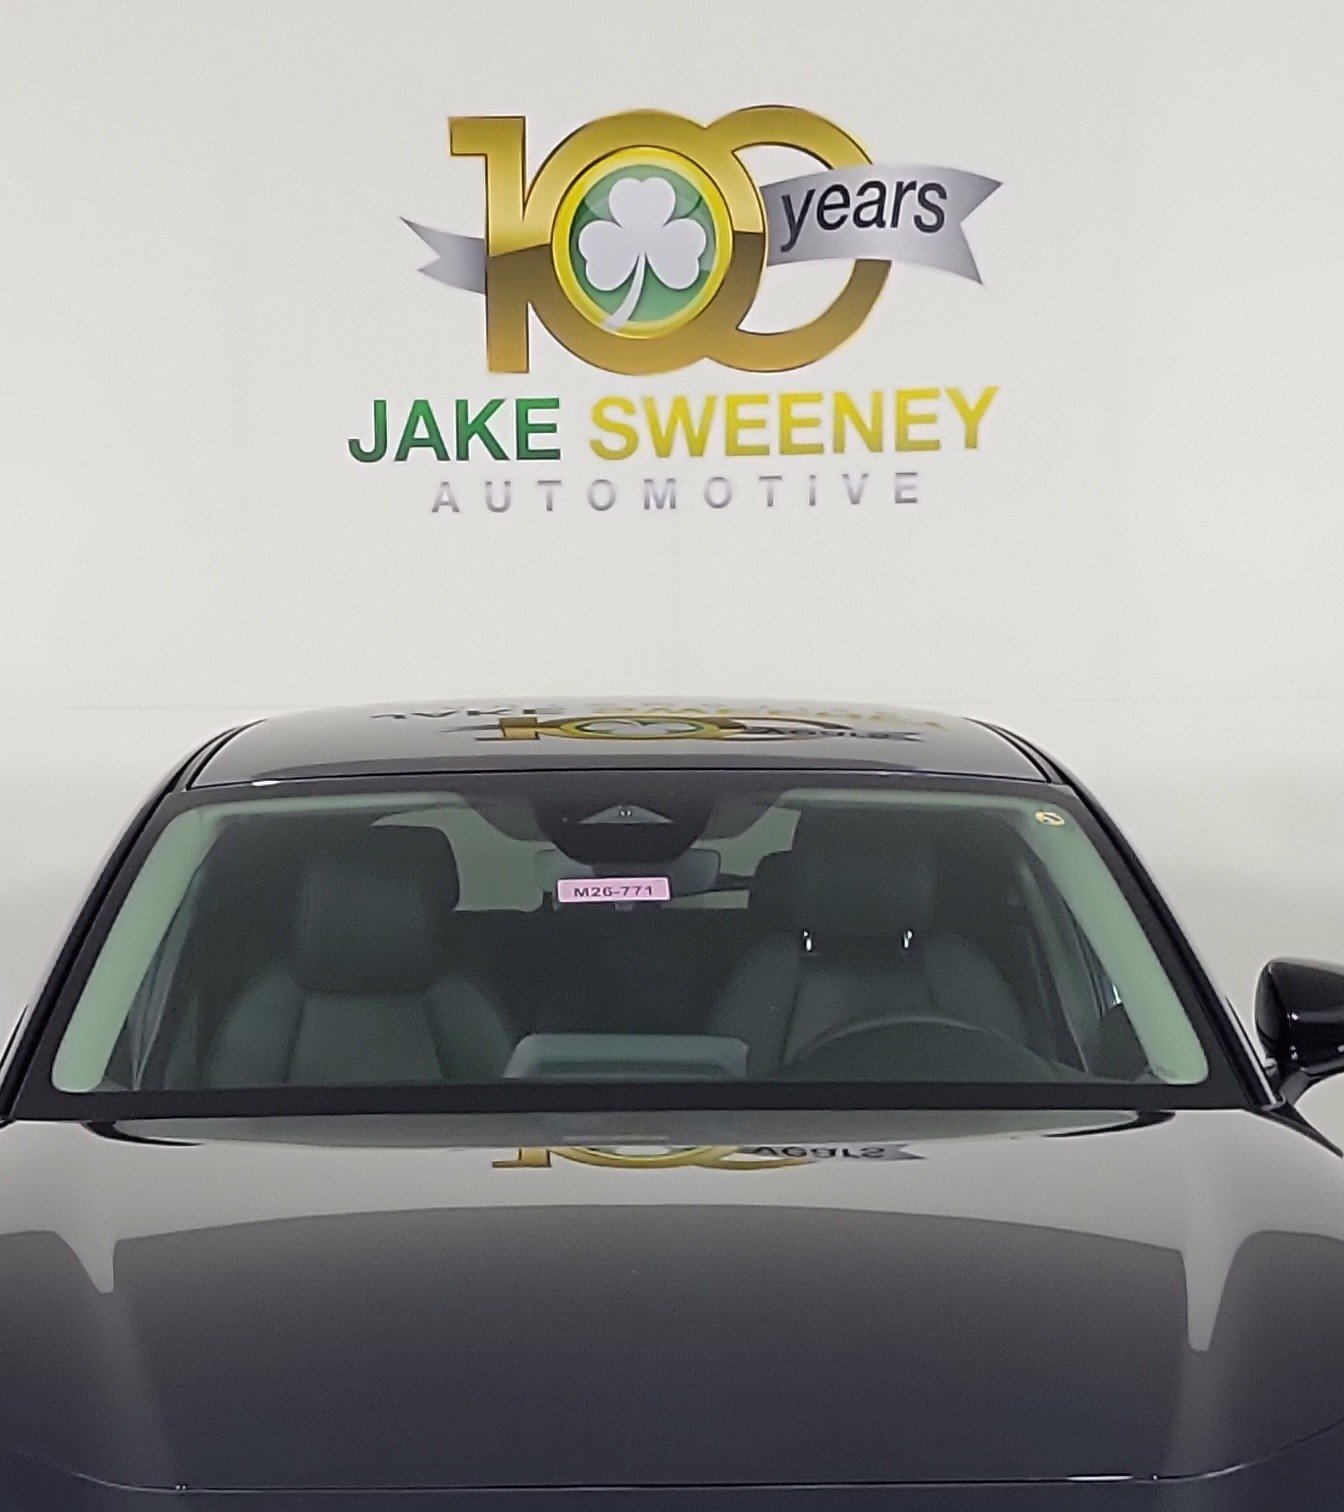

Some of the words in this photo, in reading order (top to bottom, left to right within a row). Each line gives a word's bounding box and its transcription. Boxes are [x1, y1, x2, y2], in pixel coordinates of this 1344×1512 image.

[448, 104, 892, 375] 100
[780, 179, 948, 253] years
[348, 397, 561, 463] JAKE
[590, 386, 999, 461] SWEENEY
[431, 472, 920, 514] AUTOMOTIVE
[573, 885, 653, 897] M26-771
